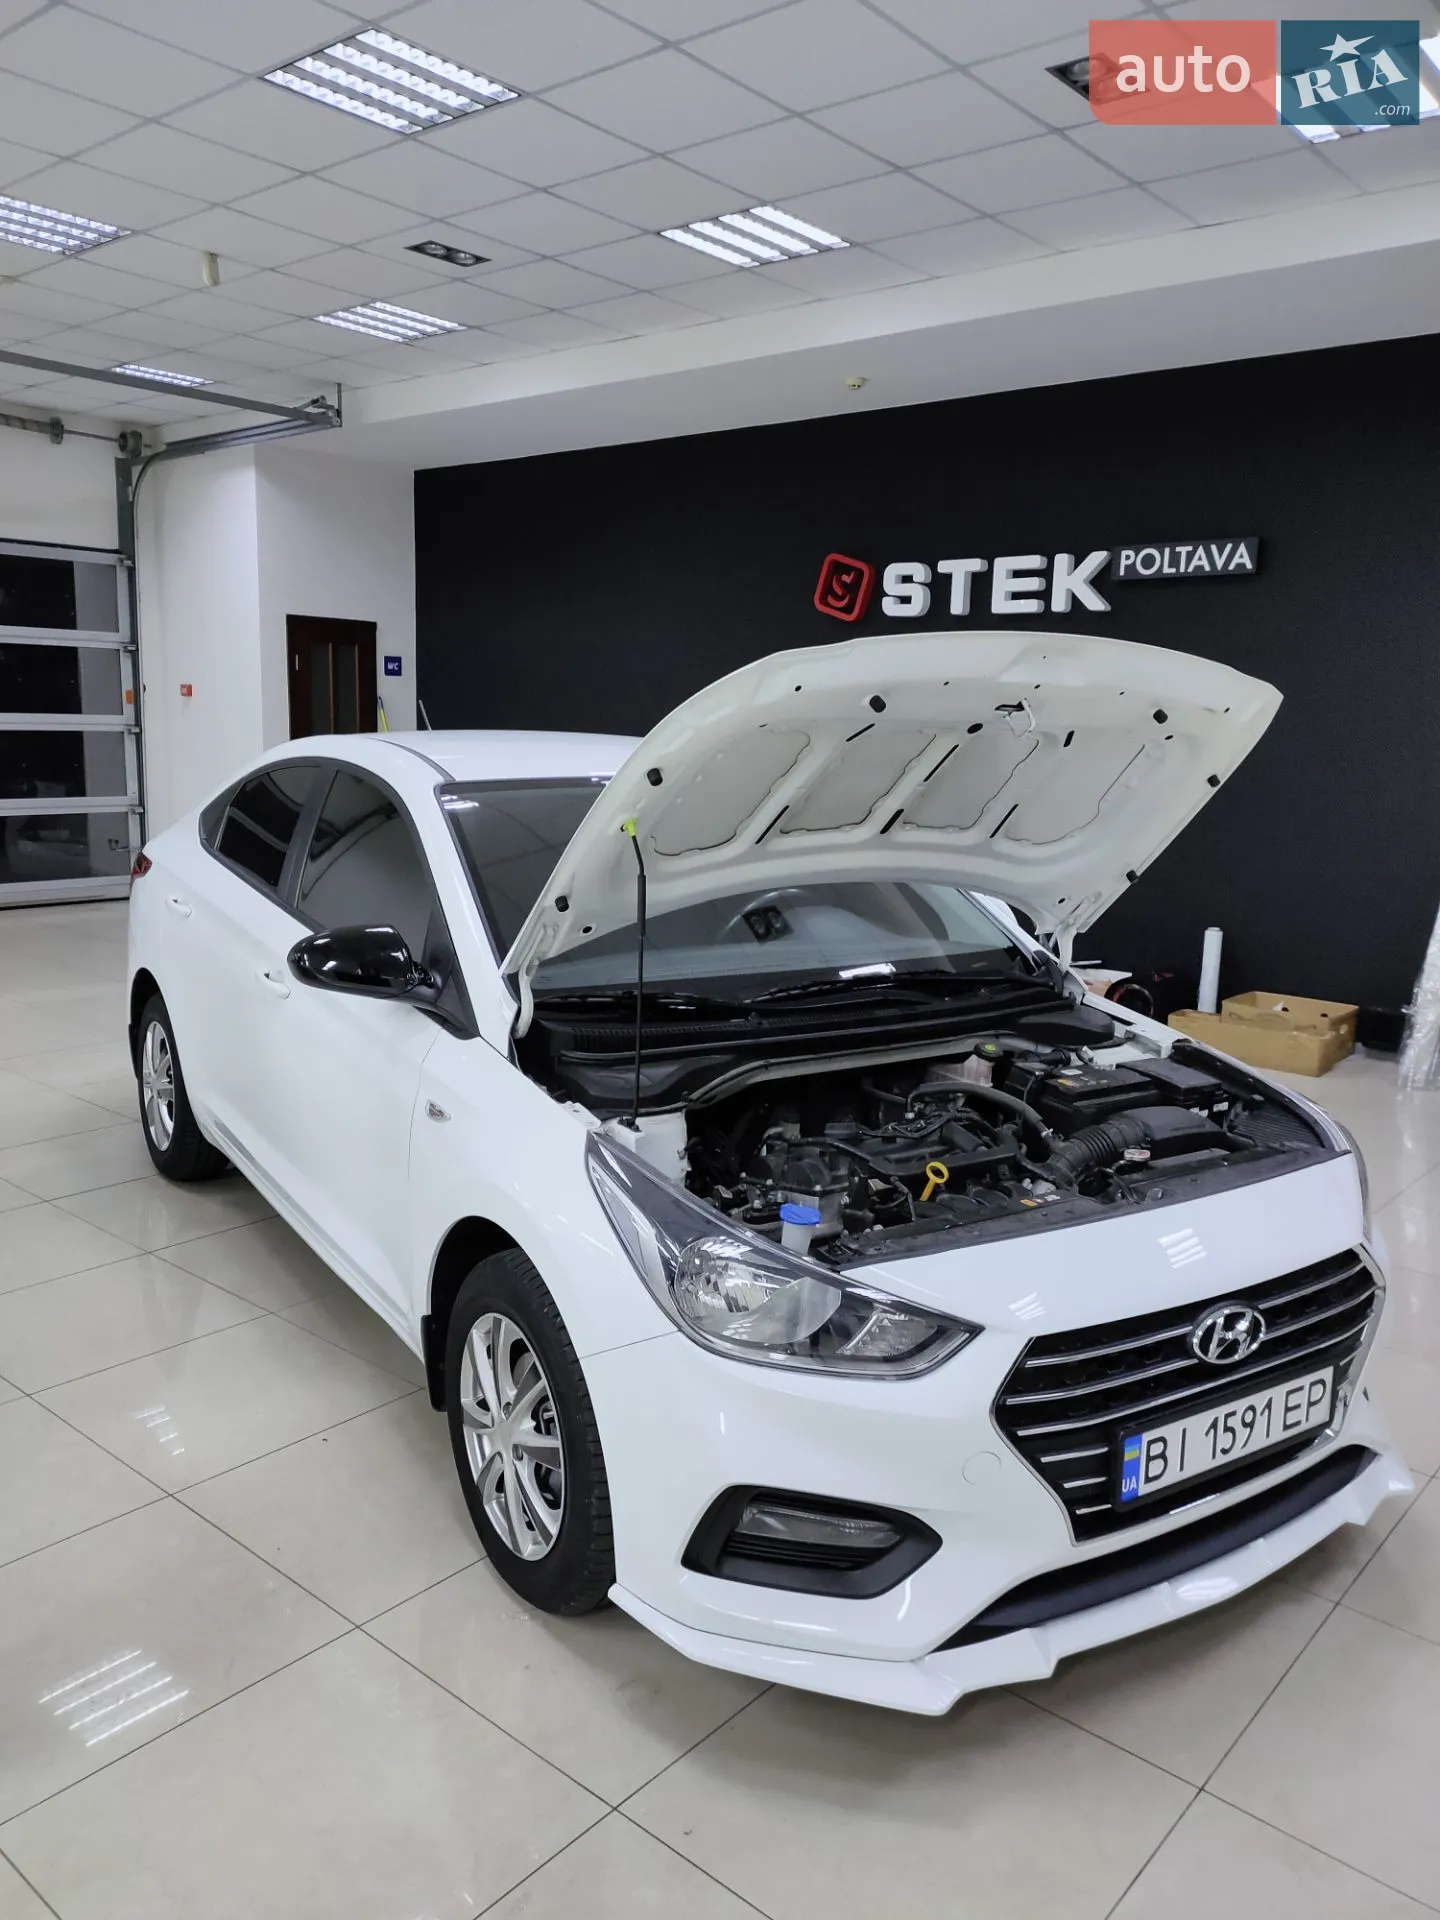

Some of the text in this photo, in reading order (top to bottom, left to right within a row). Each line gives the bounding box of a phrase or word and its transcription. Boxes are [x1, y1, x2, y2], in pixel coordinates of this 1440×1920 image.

[1119, 542, 1253, 576] POLTAVA
[881, 550, 1112, 617] STEK
[387, 661, 399, 670] WC
[1143, 1378, 1327, 1484] BI 1591 EP
[1121, 1475, 1137, 1493] UA
